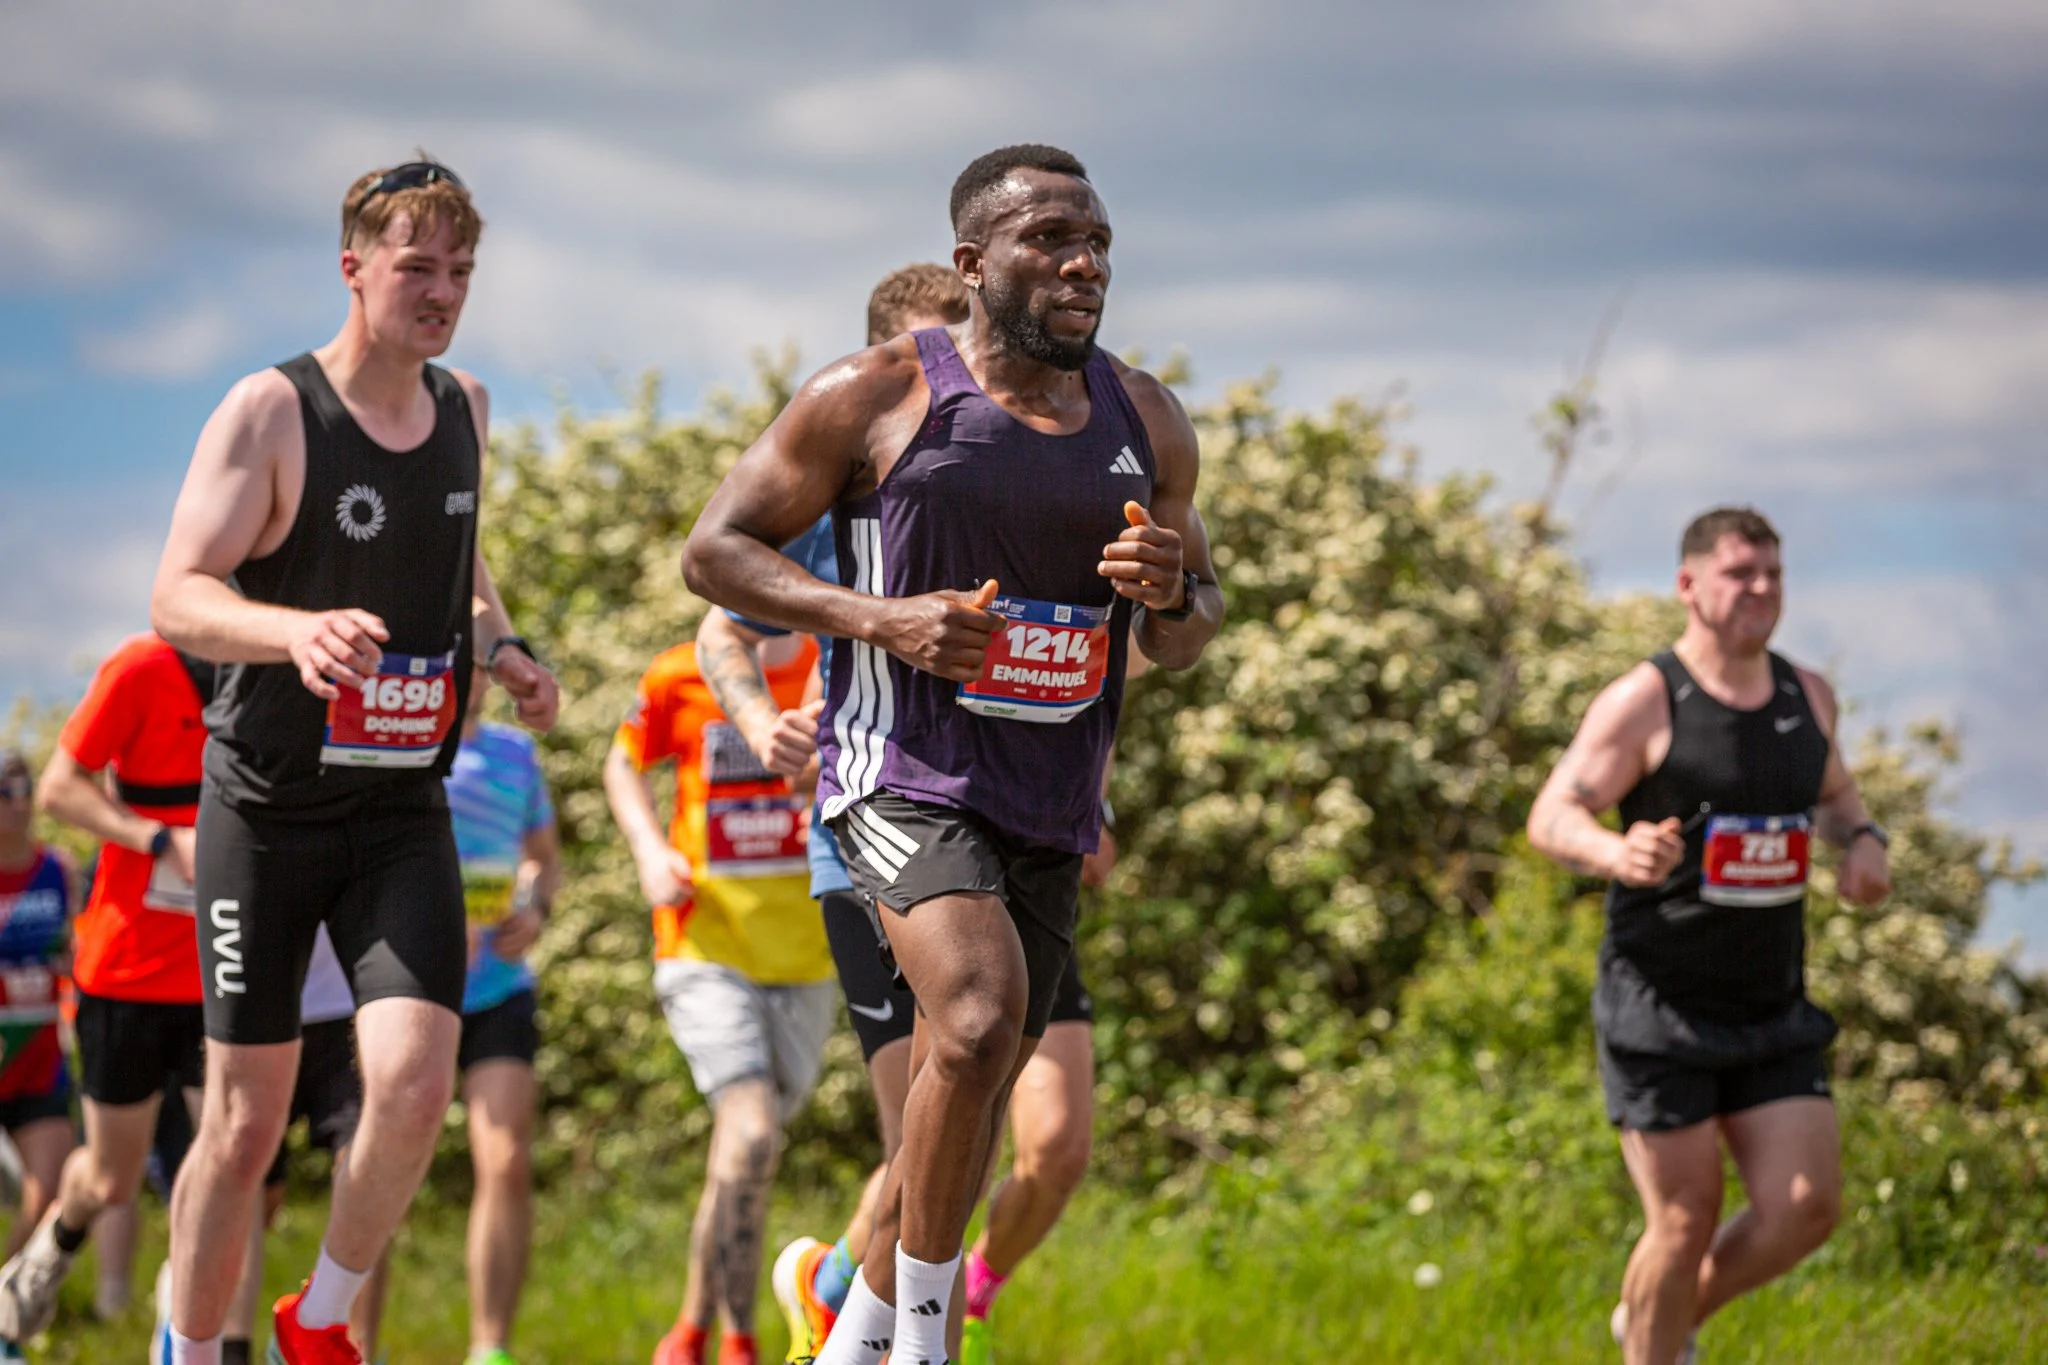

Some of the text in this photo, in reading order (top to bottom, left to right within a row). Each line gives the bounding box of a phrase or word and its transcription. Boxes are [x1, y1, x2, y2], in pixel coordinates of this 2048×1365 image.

[1007, 625, 1090, 664] 1214
[360, 676, 446, 713] 1698
[992, 664, 1087, 688] EMMANUEL
[210, 899, 247, 995] UVU
